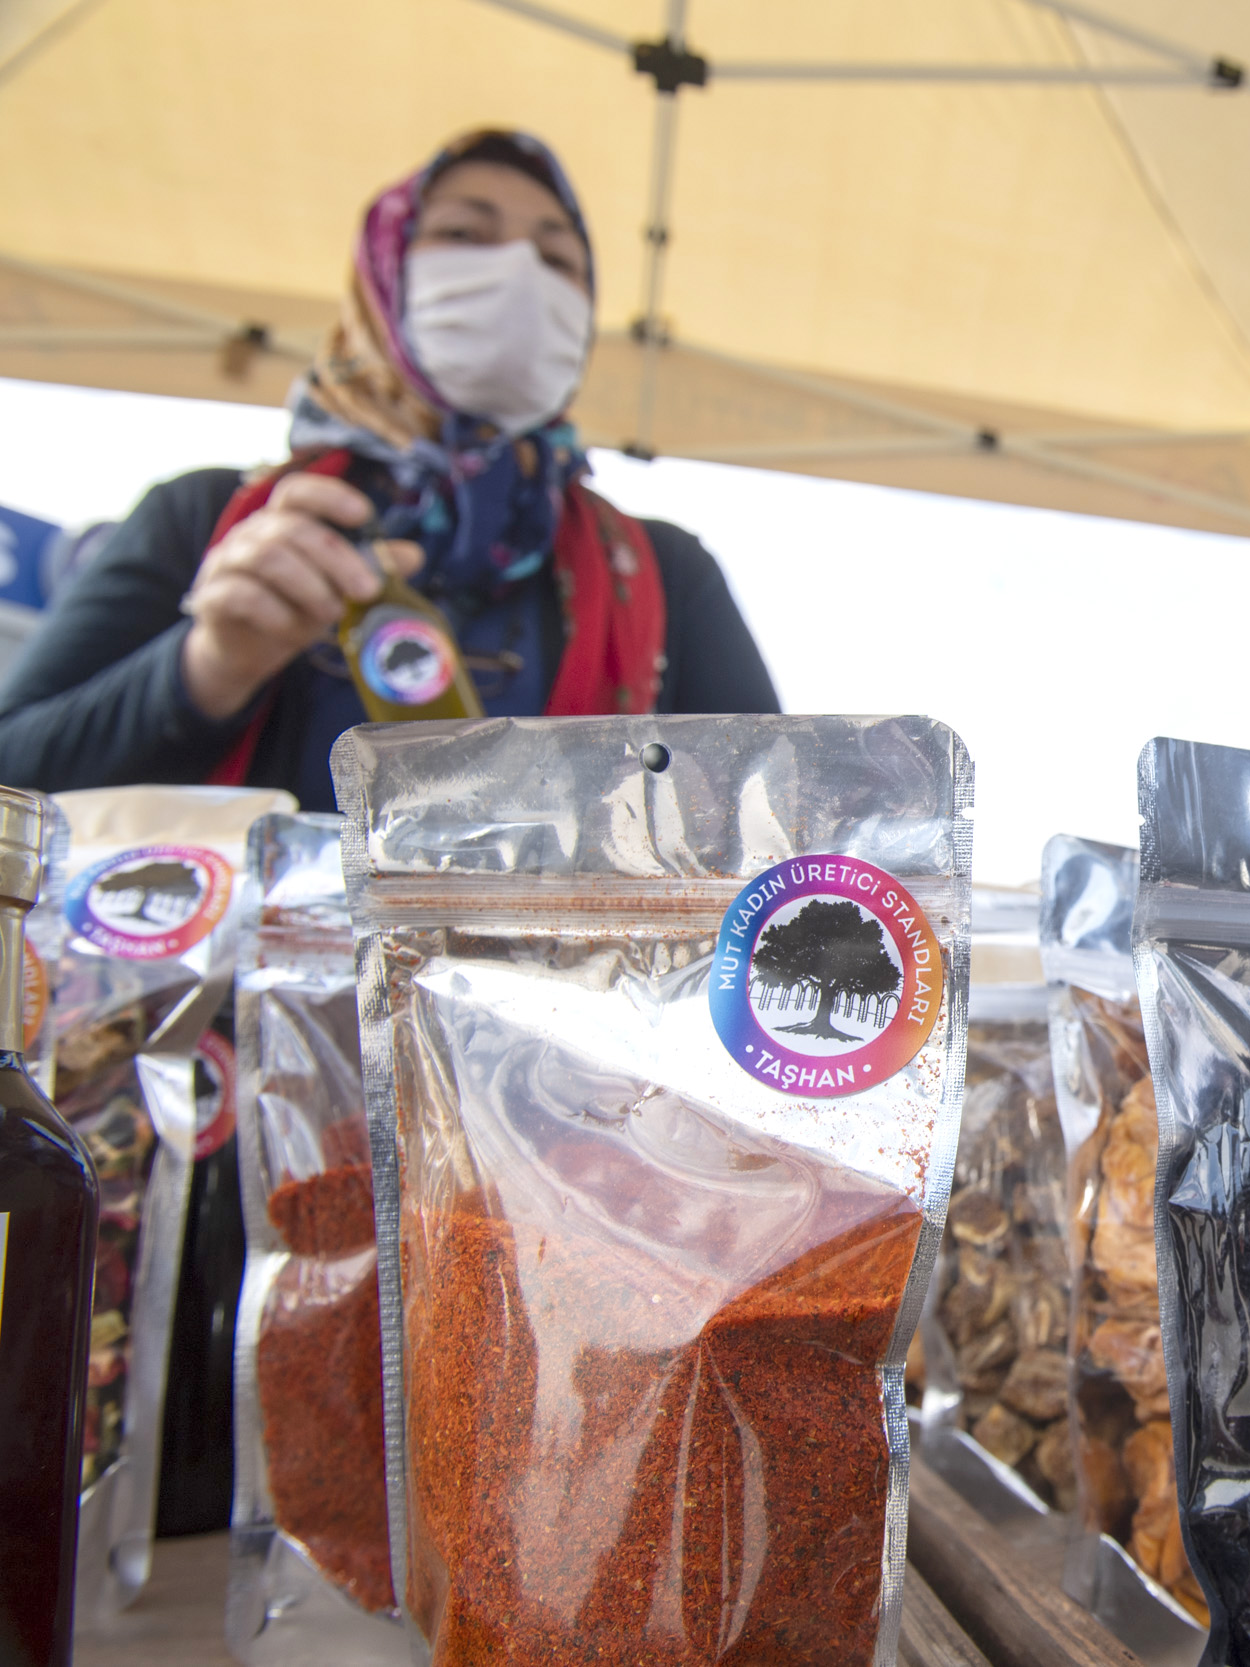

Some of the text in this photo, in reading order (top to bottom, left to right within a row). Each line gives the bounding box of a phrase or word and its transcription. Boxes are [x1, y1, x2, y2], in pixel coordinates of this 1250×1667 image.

[718, 863, 932, 1026] MUT KADIN ÜRETİCİ STANDLARI
[754, 1049, 856, 1089] TAŞHAN
